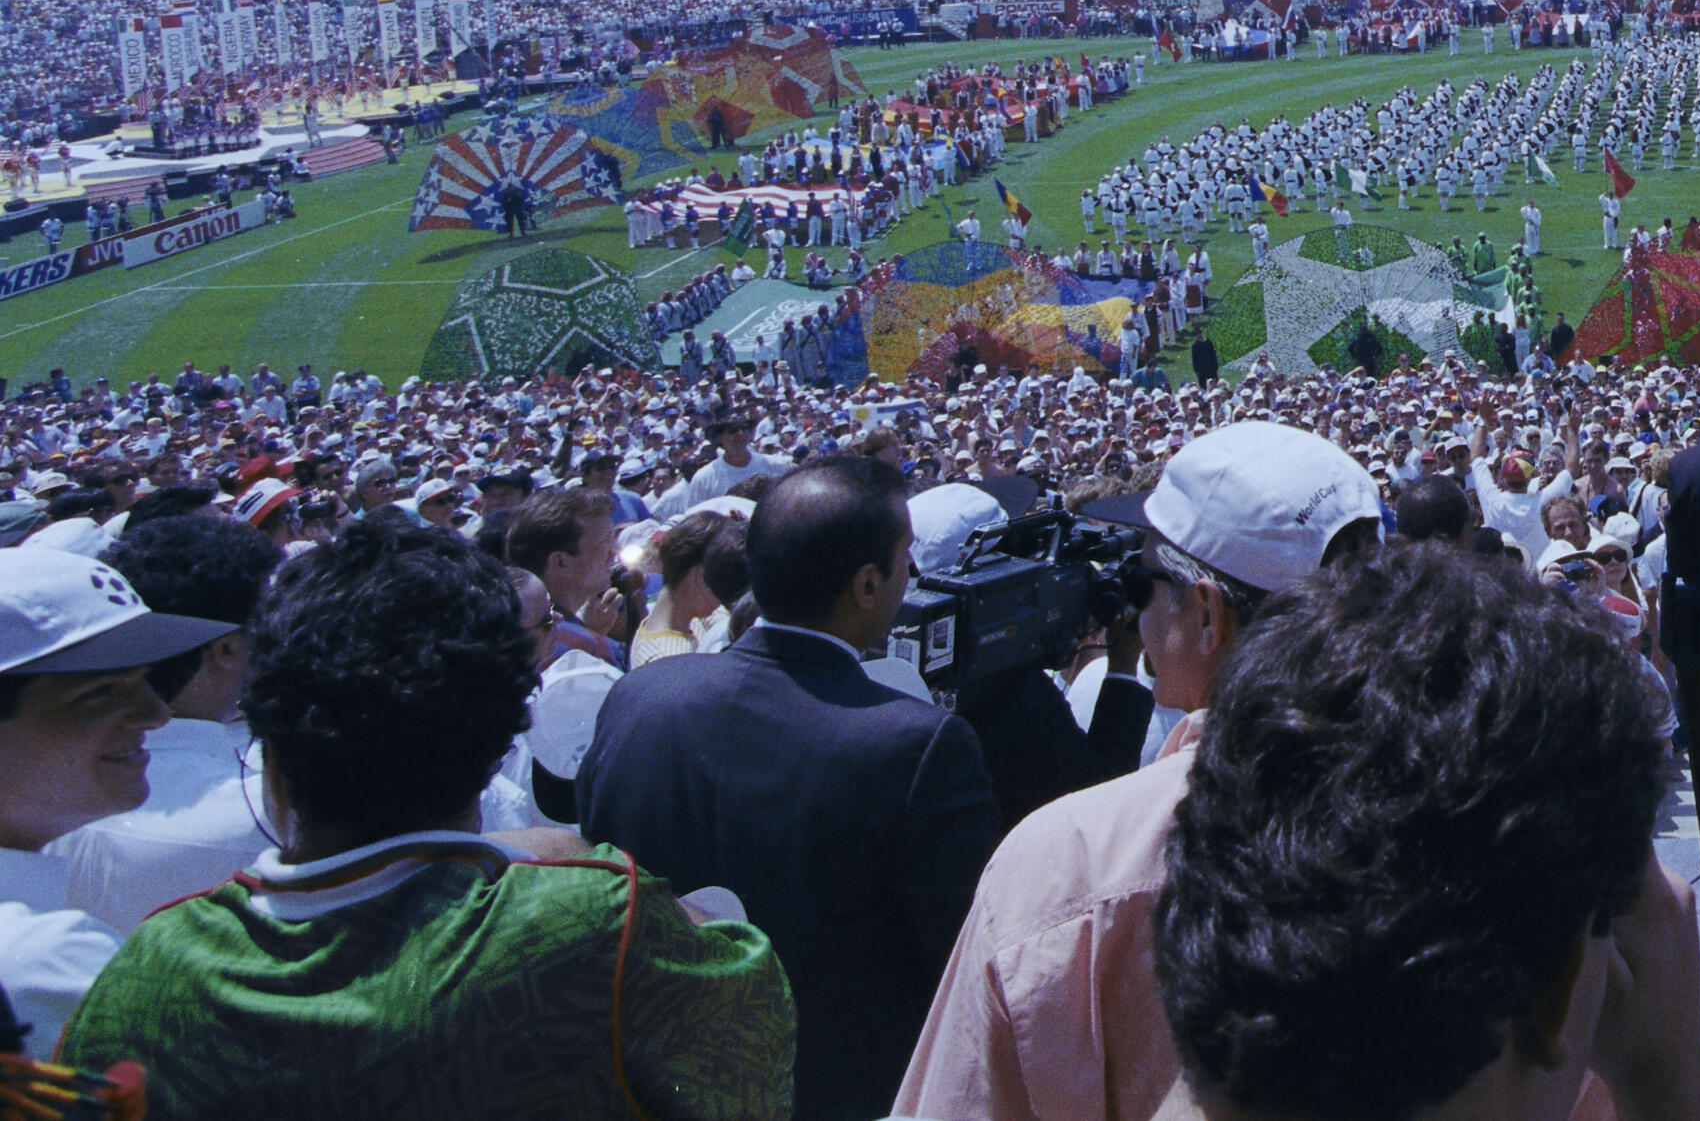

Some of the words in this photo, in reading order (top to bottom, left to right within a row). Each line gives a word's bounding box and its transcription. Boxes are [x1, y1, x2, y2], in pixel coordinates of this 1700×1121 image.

[312, 8, 325, 52] RUSSIA
[383, 9, 398, 51] SPAIN
[995, 2, 1060, 14] PONTIAC
[167, 32, 184, 81] MOROCCO
[223, 18, 238, 64] NIGERIA
[240, 14, 253, 59] NORWAY
[125, 37, 142, 85] MEXICO
[153, 211, 241, 255] Canon
